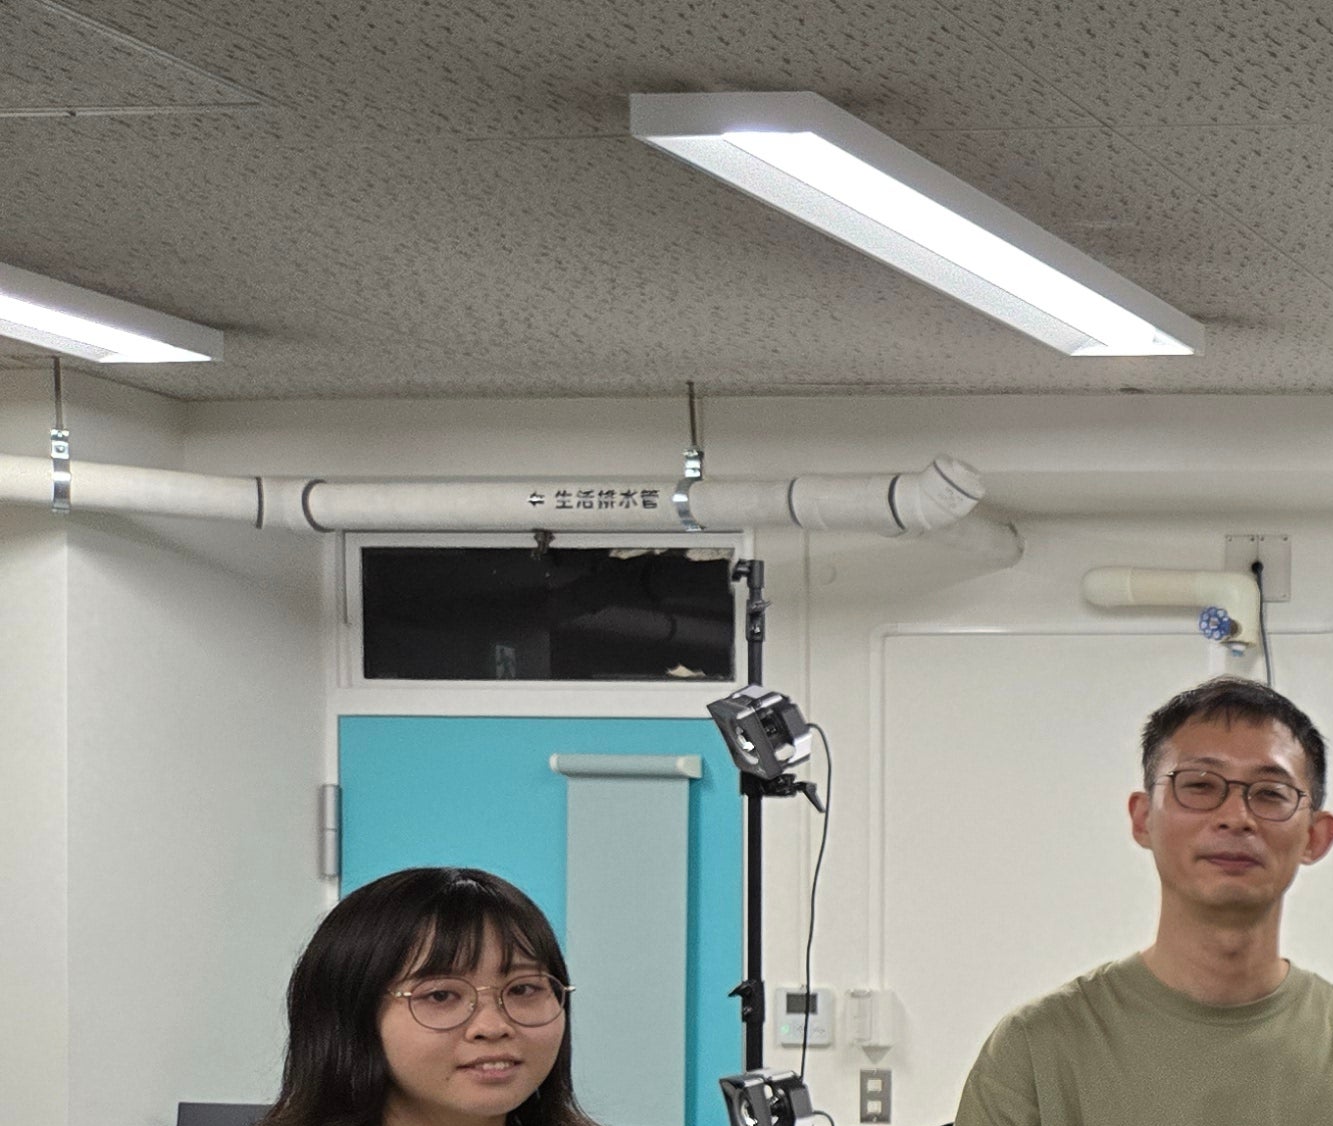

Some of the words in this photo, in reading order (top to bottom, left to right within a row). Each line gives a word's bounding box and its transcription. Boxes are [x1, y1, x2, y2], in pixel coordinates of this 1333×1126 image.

[554, 489, 660, 510] 生活排水管
